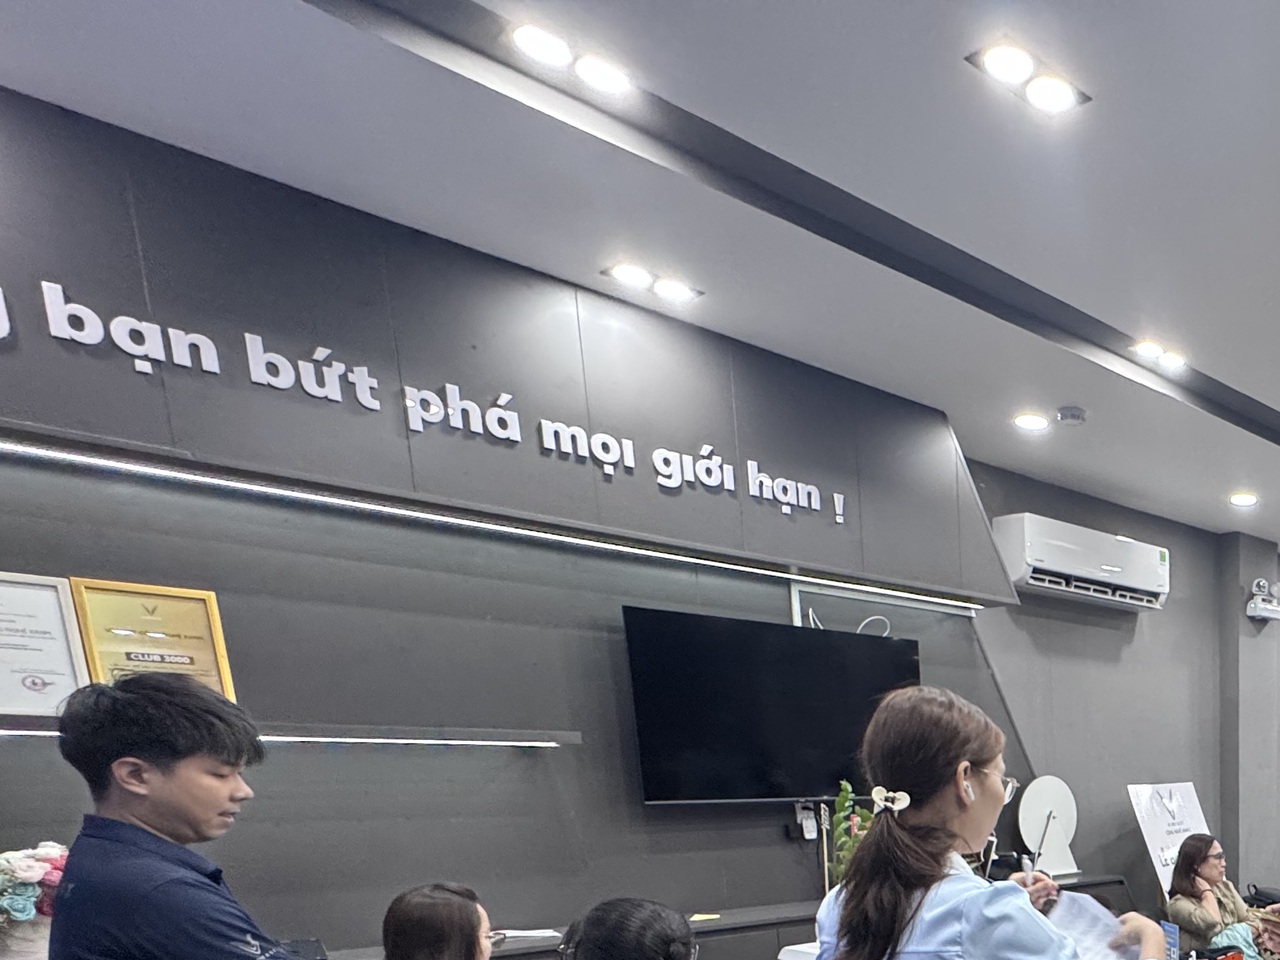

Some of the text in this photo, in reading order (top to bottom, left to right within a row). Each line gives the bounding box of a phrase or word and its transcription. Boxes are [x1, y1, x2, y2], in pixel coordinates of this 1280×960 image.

[41, 280, 221, 375] bạn
[244, 332, 381, 411] bứt
[403, 383, 522, 443] phá
[540, 418, 636, 476] mọi
[652, 444, 736, 490] giới
[747, 460, 822, 515] hạn
[833, 492, 845, 524] !
[130, 653, 191, 664] CLUB 3000
